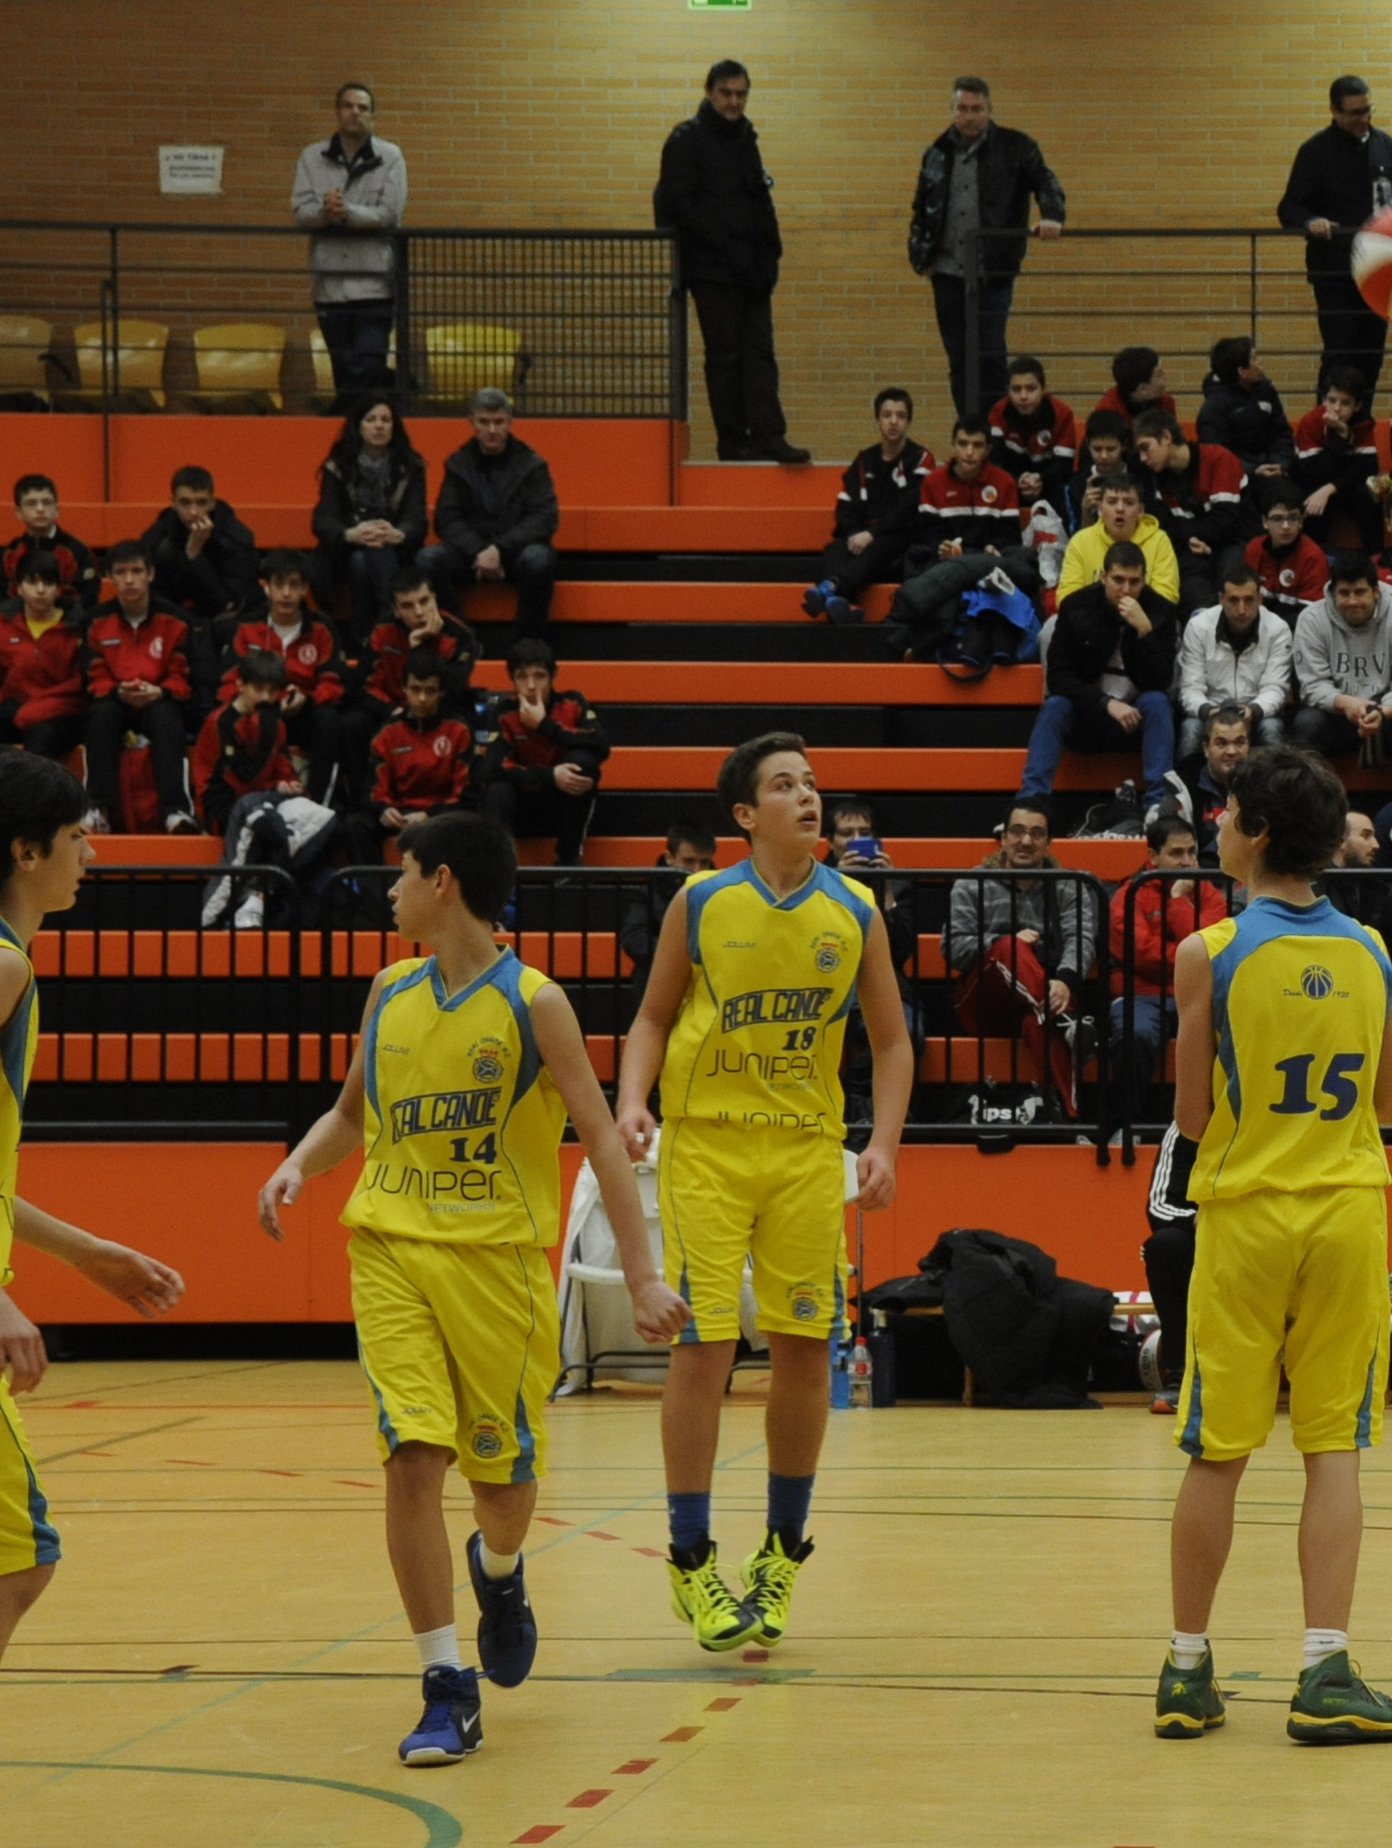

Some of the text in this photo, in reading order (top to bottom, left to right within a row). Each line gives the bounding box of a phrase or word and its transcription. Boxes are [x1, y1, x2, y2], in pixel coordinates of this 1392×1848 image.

[722, 992, 767, 1033] REAL
[782, 1026, 817, 1051] 18
[1269, 1053, 1366, 1121] 15
[430, 1090, 499, 1129] CANOE
[449, 1131, 498, 1164] 14
